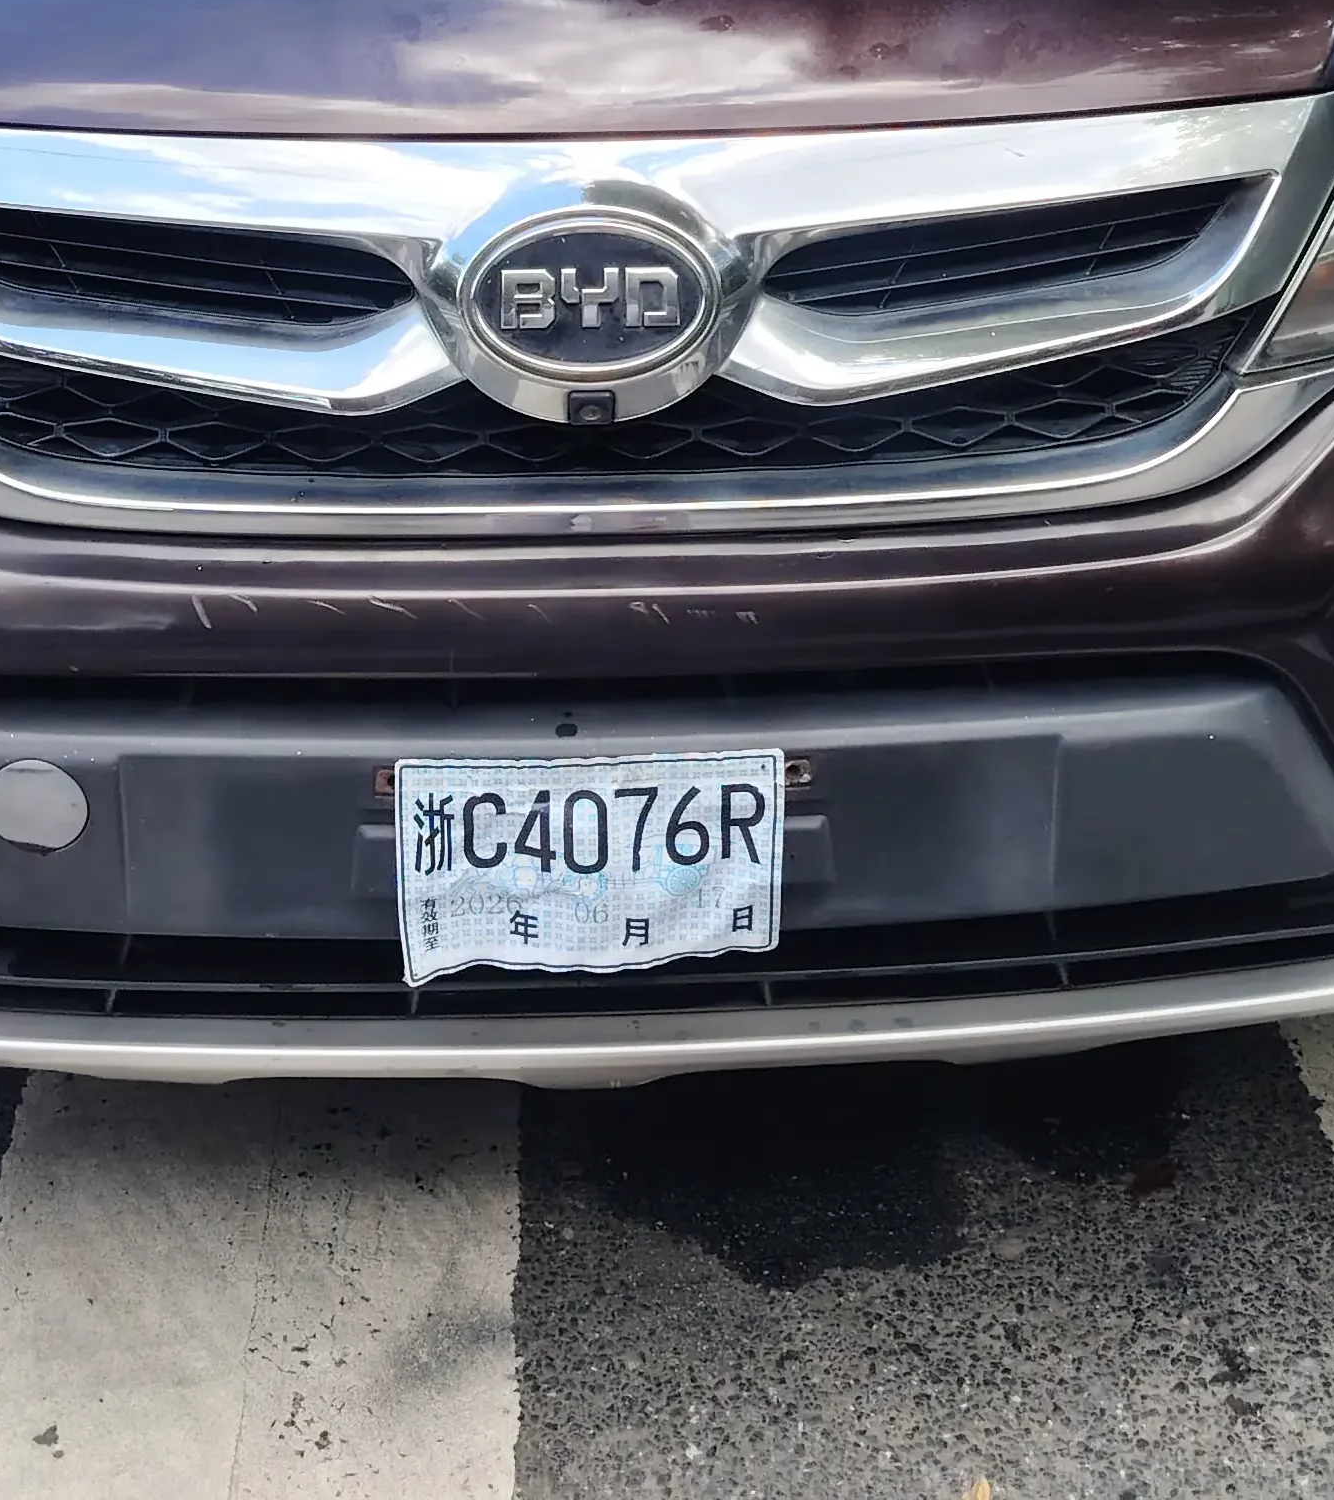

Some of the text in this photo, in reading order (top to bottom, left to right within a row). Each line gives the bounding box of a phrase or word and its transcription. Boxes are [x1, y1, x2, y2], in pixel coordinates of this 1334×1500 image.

[500, 266, 681, 330] BYD
[414, 782, 766, 876] 浙C4076R
[421, 899, 442, 952] 有效期至
[510, 910, 539, 945] 年
[622, 918, 650, 947] 月
[732, 905, 754, 933] 日
